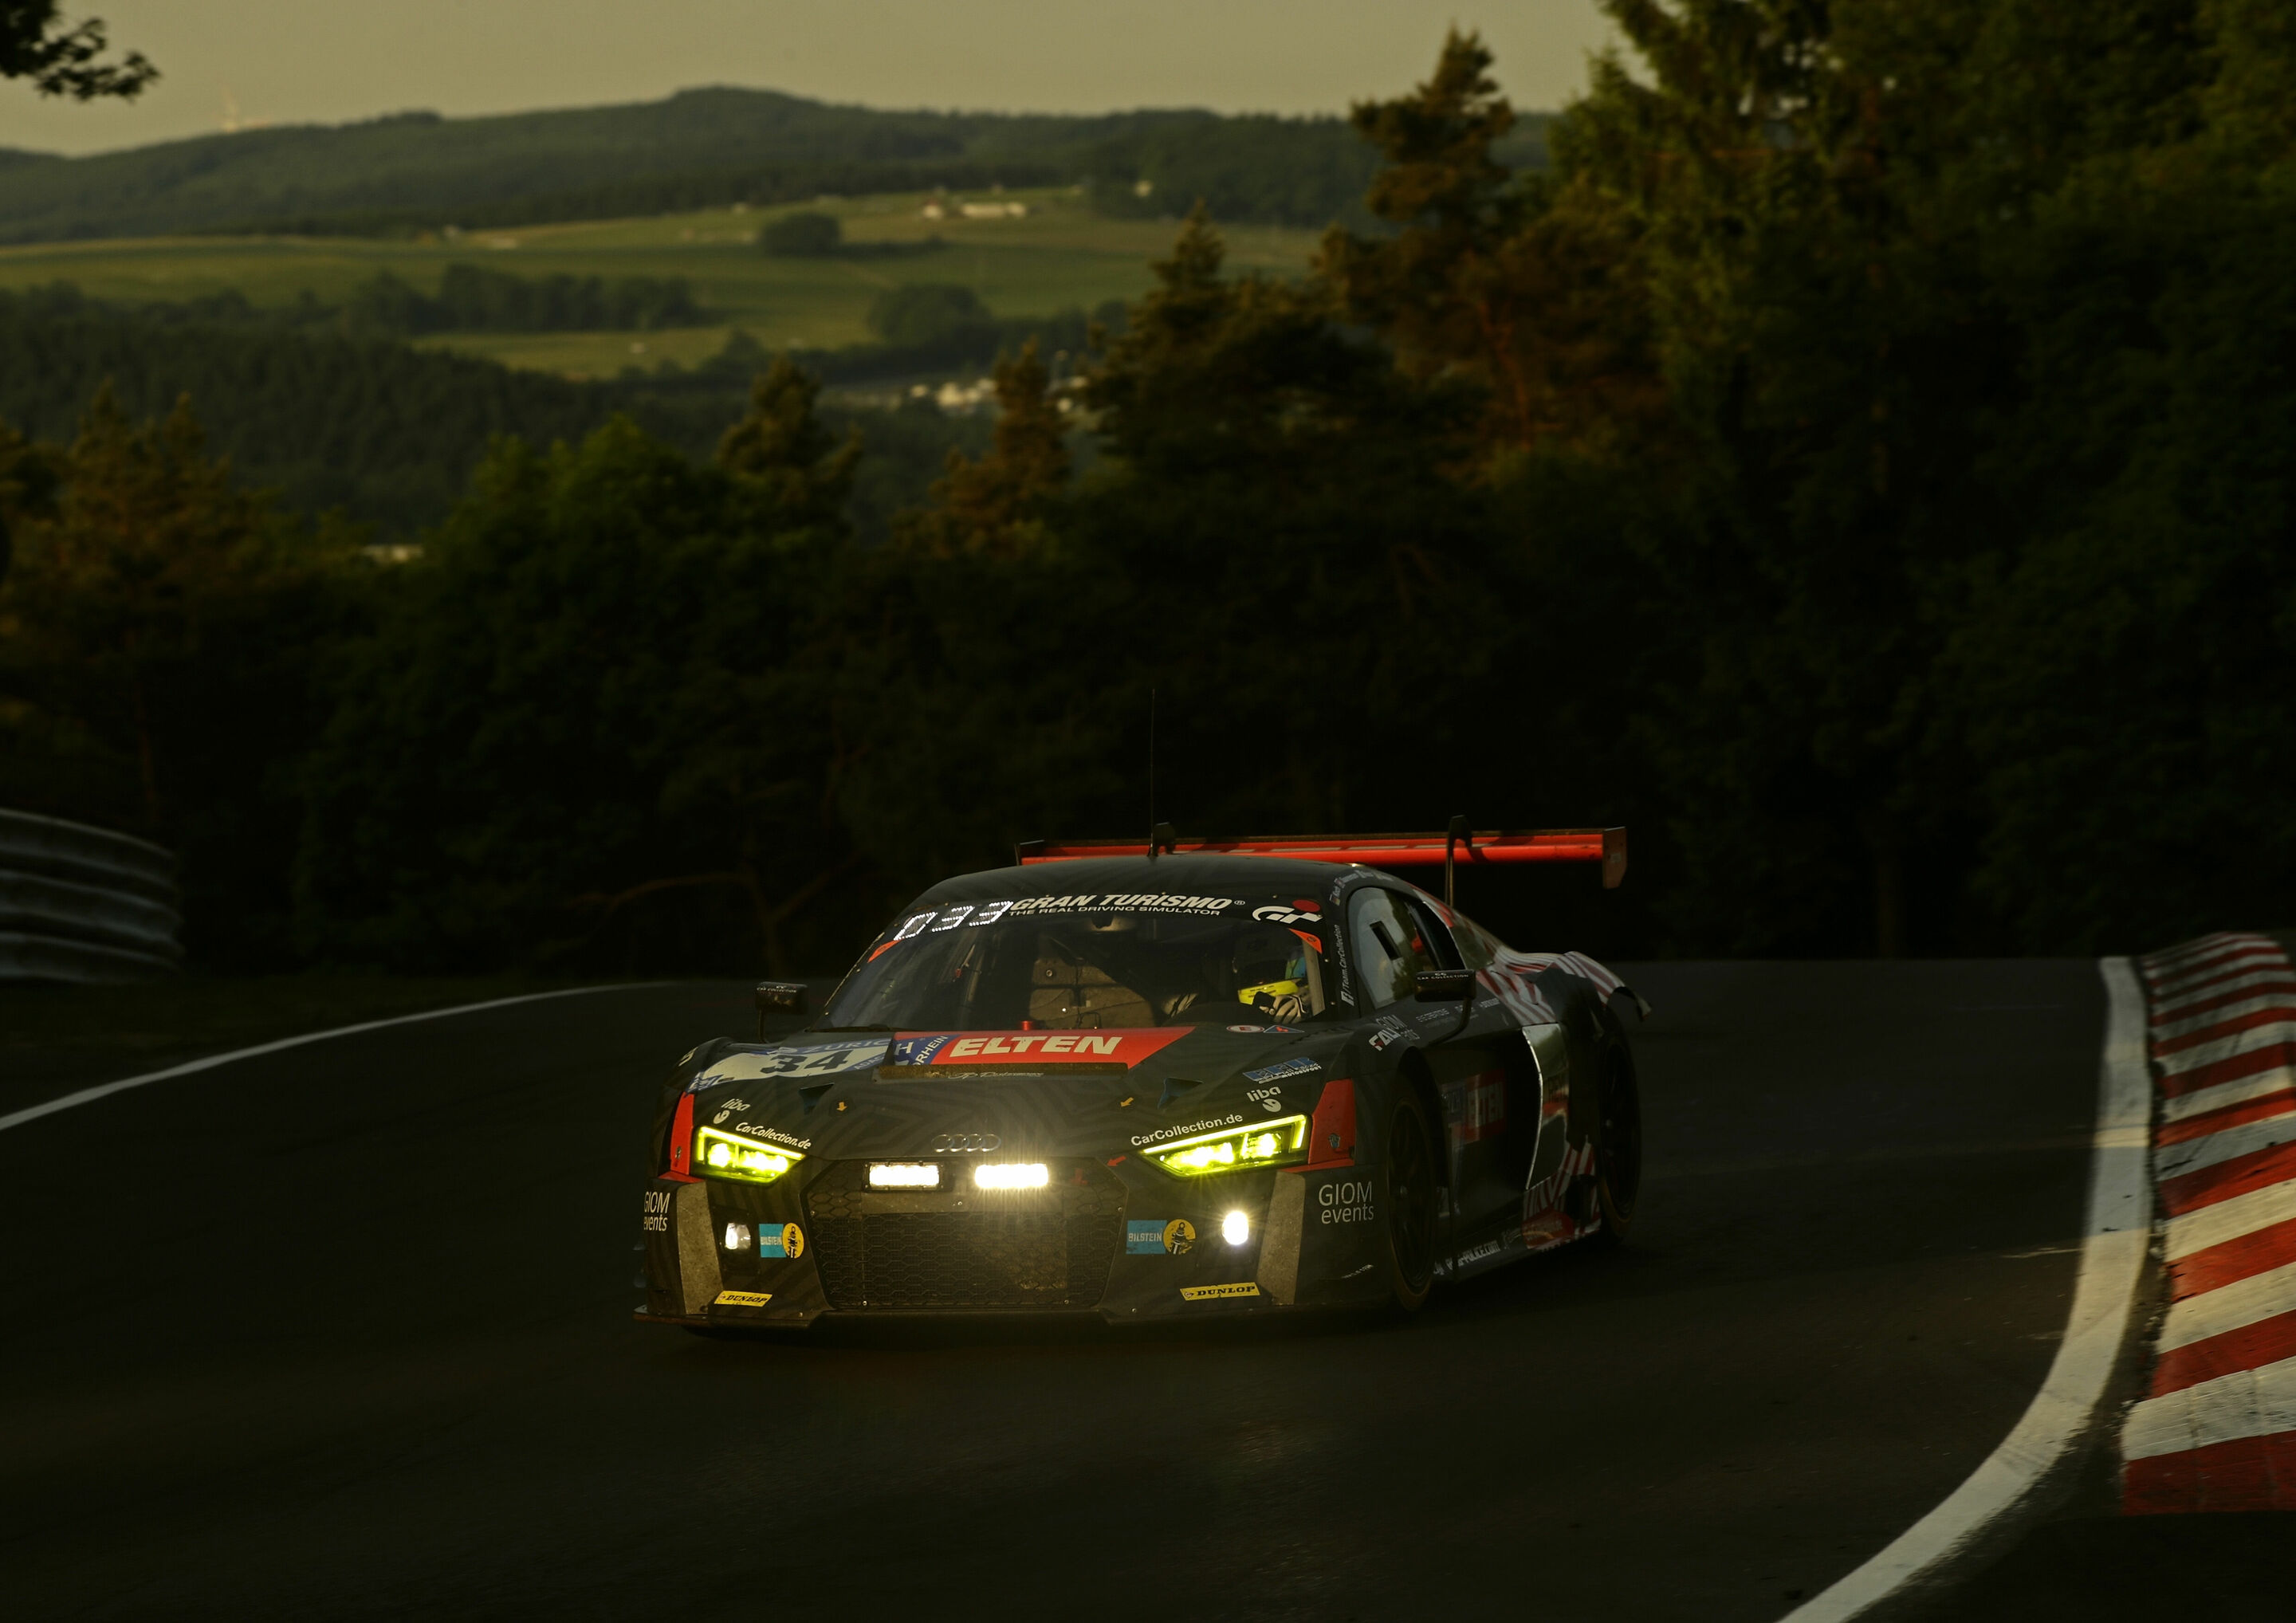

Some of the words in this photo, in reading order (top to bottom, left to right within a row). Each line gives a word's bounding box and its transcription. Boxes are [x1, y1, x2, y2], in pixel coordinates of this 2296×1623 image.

[1010, 894, 1097, 910] GRAN
[1099, 894, 1233, 910] TURISMO
[1138, 906, 1221, 916] SIMULATOR
[949, 1036, 1122, 1058] ELTEN
[760, 1049, 854, 1074] 34
[1246, 1085, 1282, 1102] liba
[735, 1122, 812, 1150] CarCollection.de
[1130, 1113, 1244, 1147] CarCollection.de
[643, 1191, 670, 1213] GIOM
[1318, 1180, 1373, 1206] GIOM
[1320, 1203, 1374, 1224] events
[1128, 1232, 1162, 1242] BILSTEIN
[725, 1295, 769, 1303] DUNLOP
[1197, 1285, 1256, 1297] DUNLOP
